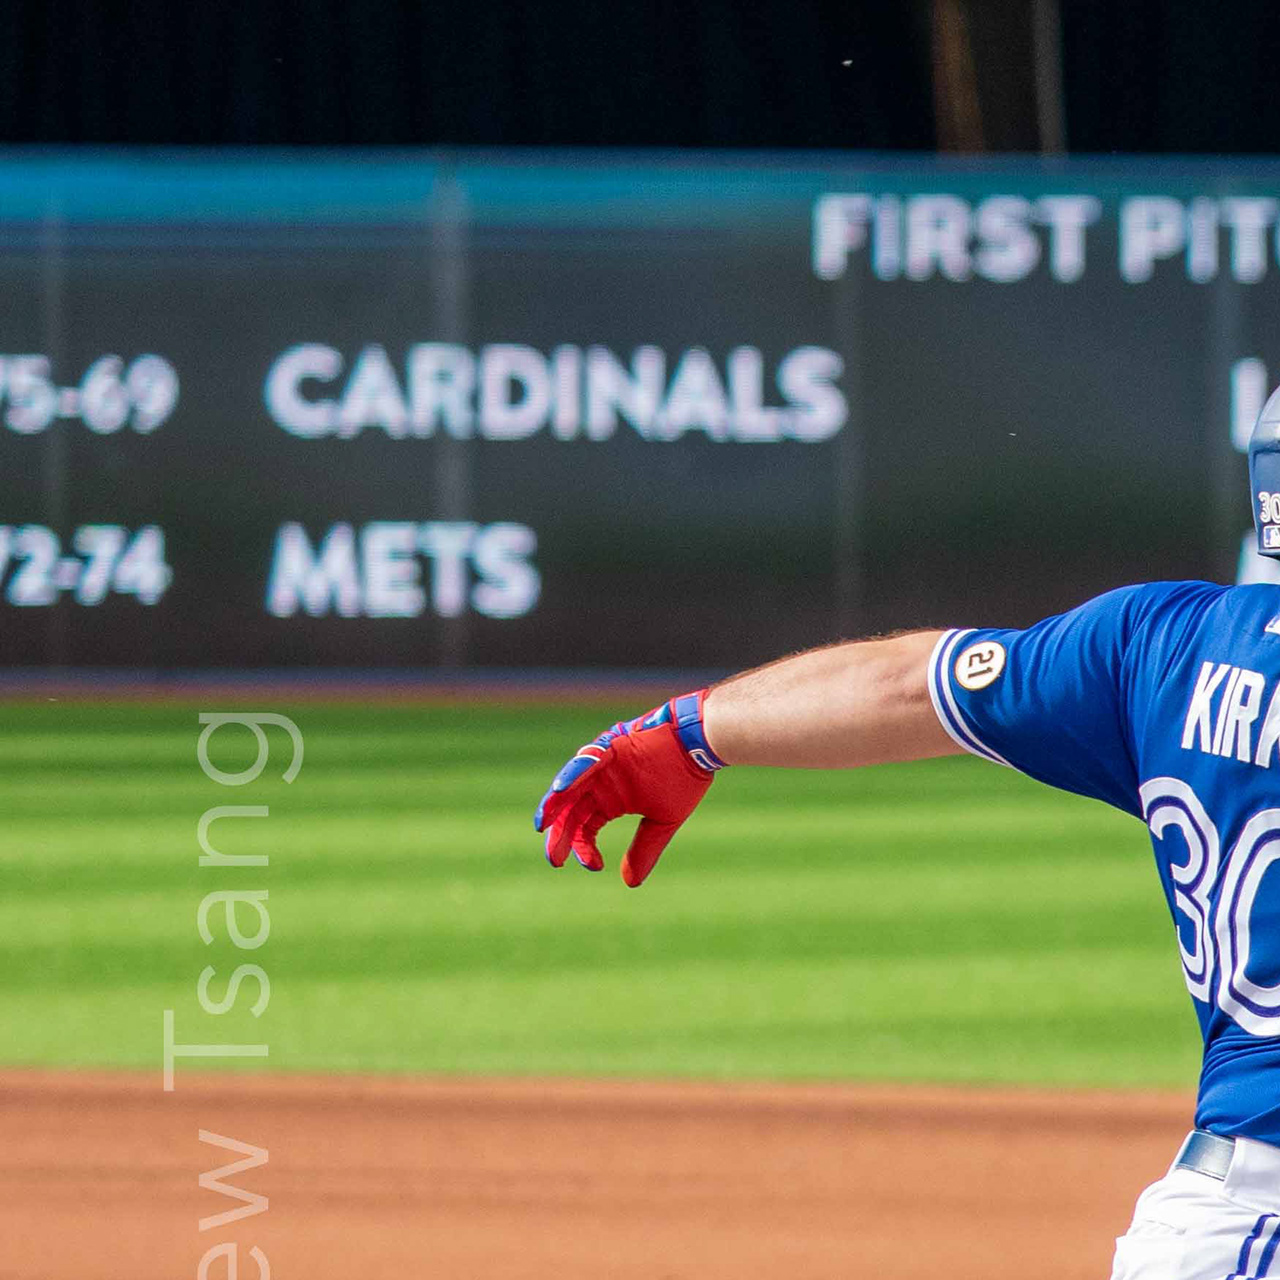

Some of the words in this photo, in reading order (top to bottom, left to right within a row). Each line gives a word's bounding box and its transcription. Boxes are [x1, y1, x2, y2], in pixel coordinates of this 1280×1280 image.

[814, 194, 1096, 283] FIRST
[0, 353, 180, 434] 5-69
[264, 343, 849, 442] CARDINALS
[0, 523, 174, 606] 2-74
[267, 521, 541, 619] METS
[968, 649, 994, 679] 21
